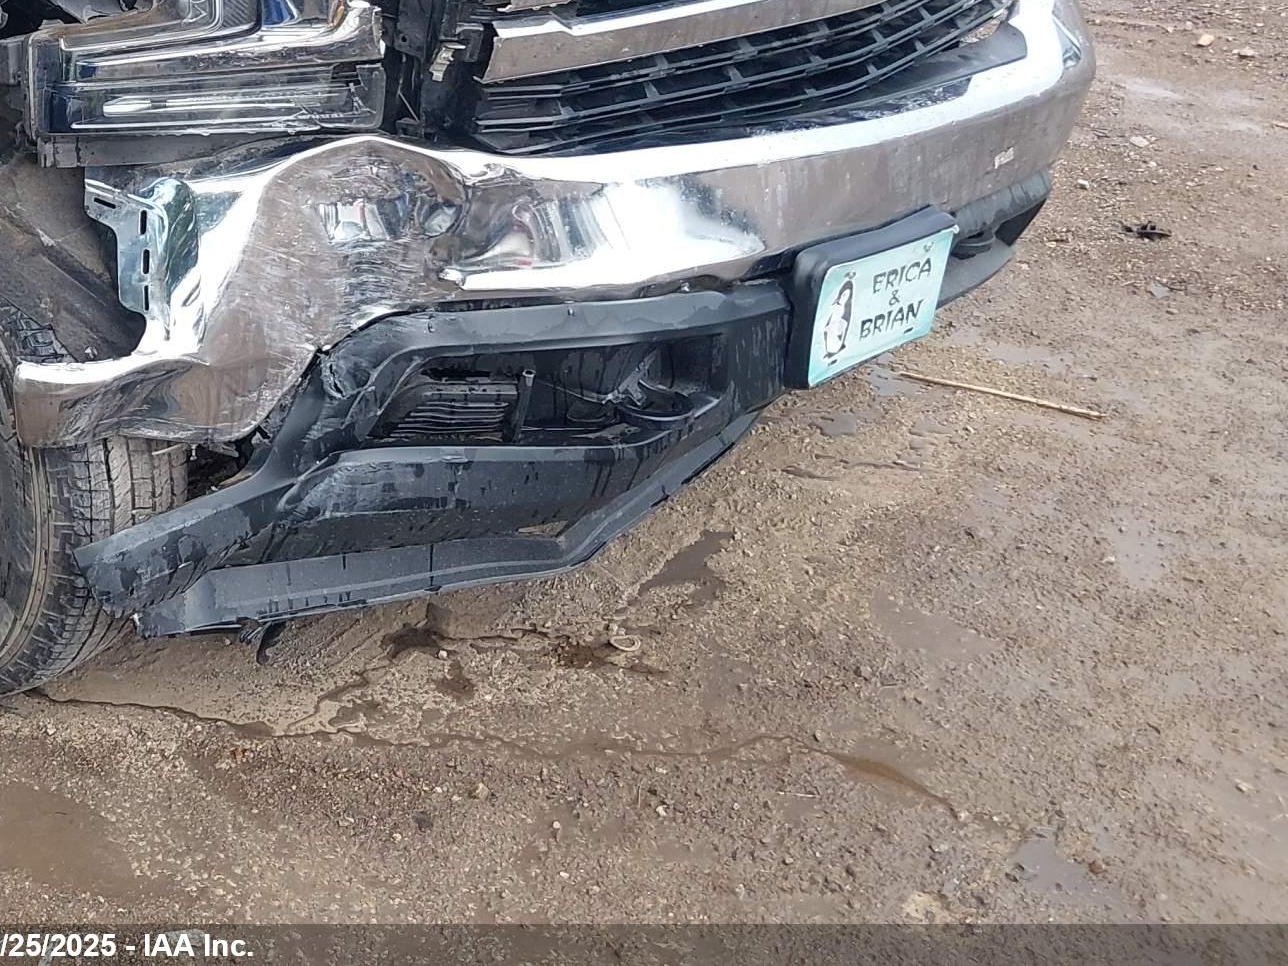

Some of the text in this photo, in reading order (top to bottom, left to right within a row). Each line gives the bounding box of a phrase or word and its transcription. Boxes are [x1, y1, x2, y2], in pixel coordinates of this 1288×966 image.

[872, 257, 932, 294] ERICA
[888, 289, 901, 306] &
[859, 299, 924, 340] BRIAN
